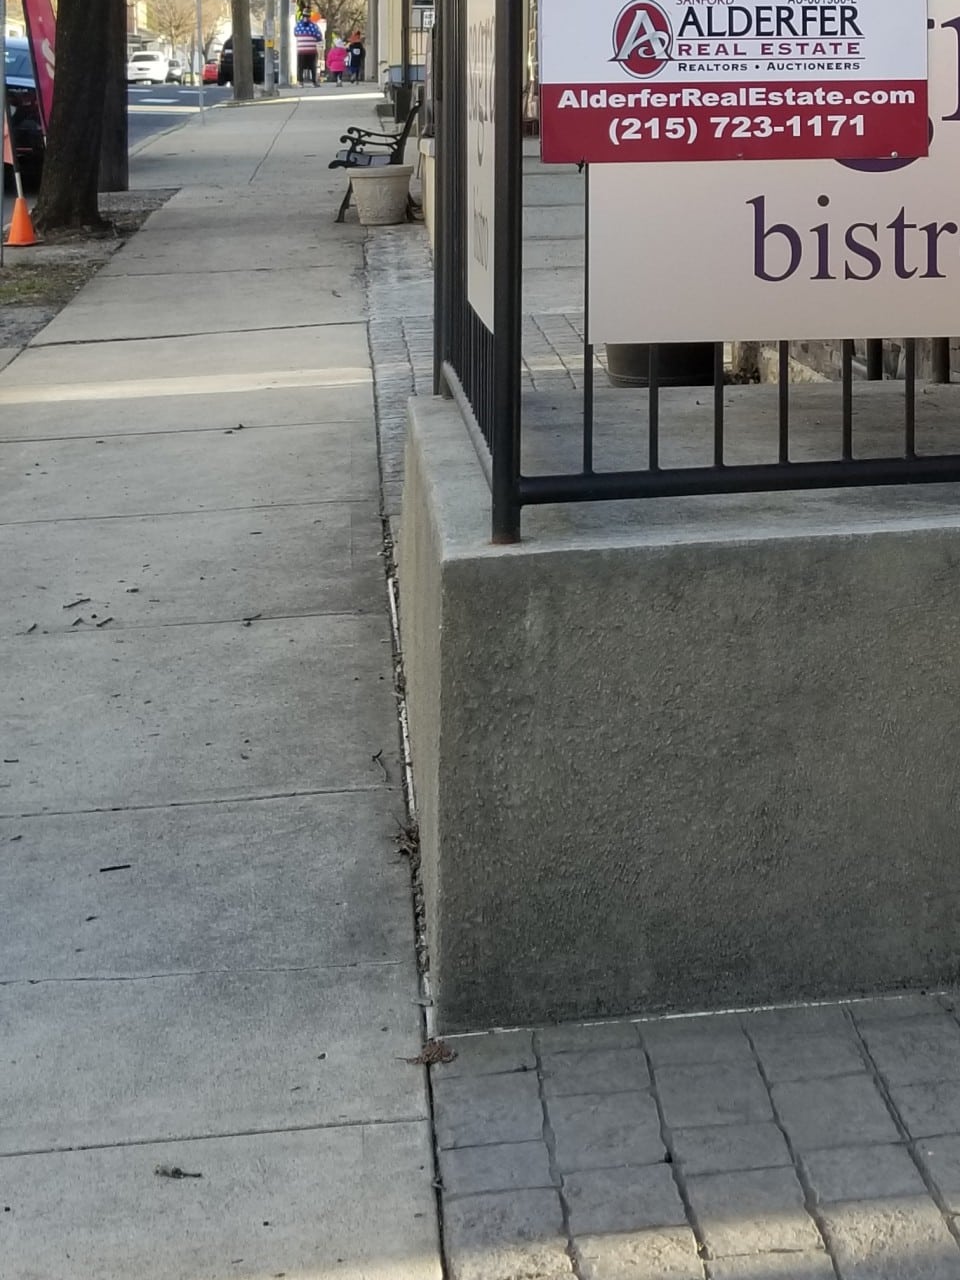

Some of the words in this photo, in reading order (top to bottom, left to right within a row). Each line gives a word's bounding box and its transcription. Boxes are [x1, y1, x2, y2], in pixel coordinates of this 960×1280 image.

[678, 6, 863, 38] ALDERFER
[678, 43, 747, 56] REAL
[761, 42, 861, 55] ESTATE
[558, 87, 915, 109] AlderferRealEstate.com
[608, 117, 698, 145] (215)
[710, 114, 865, 138] 723-1171
